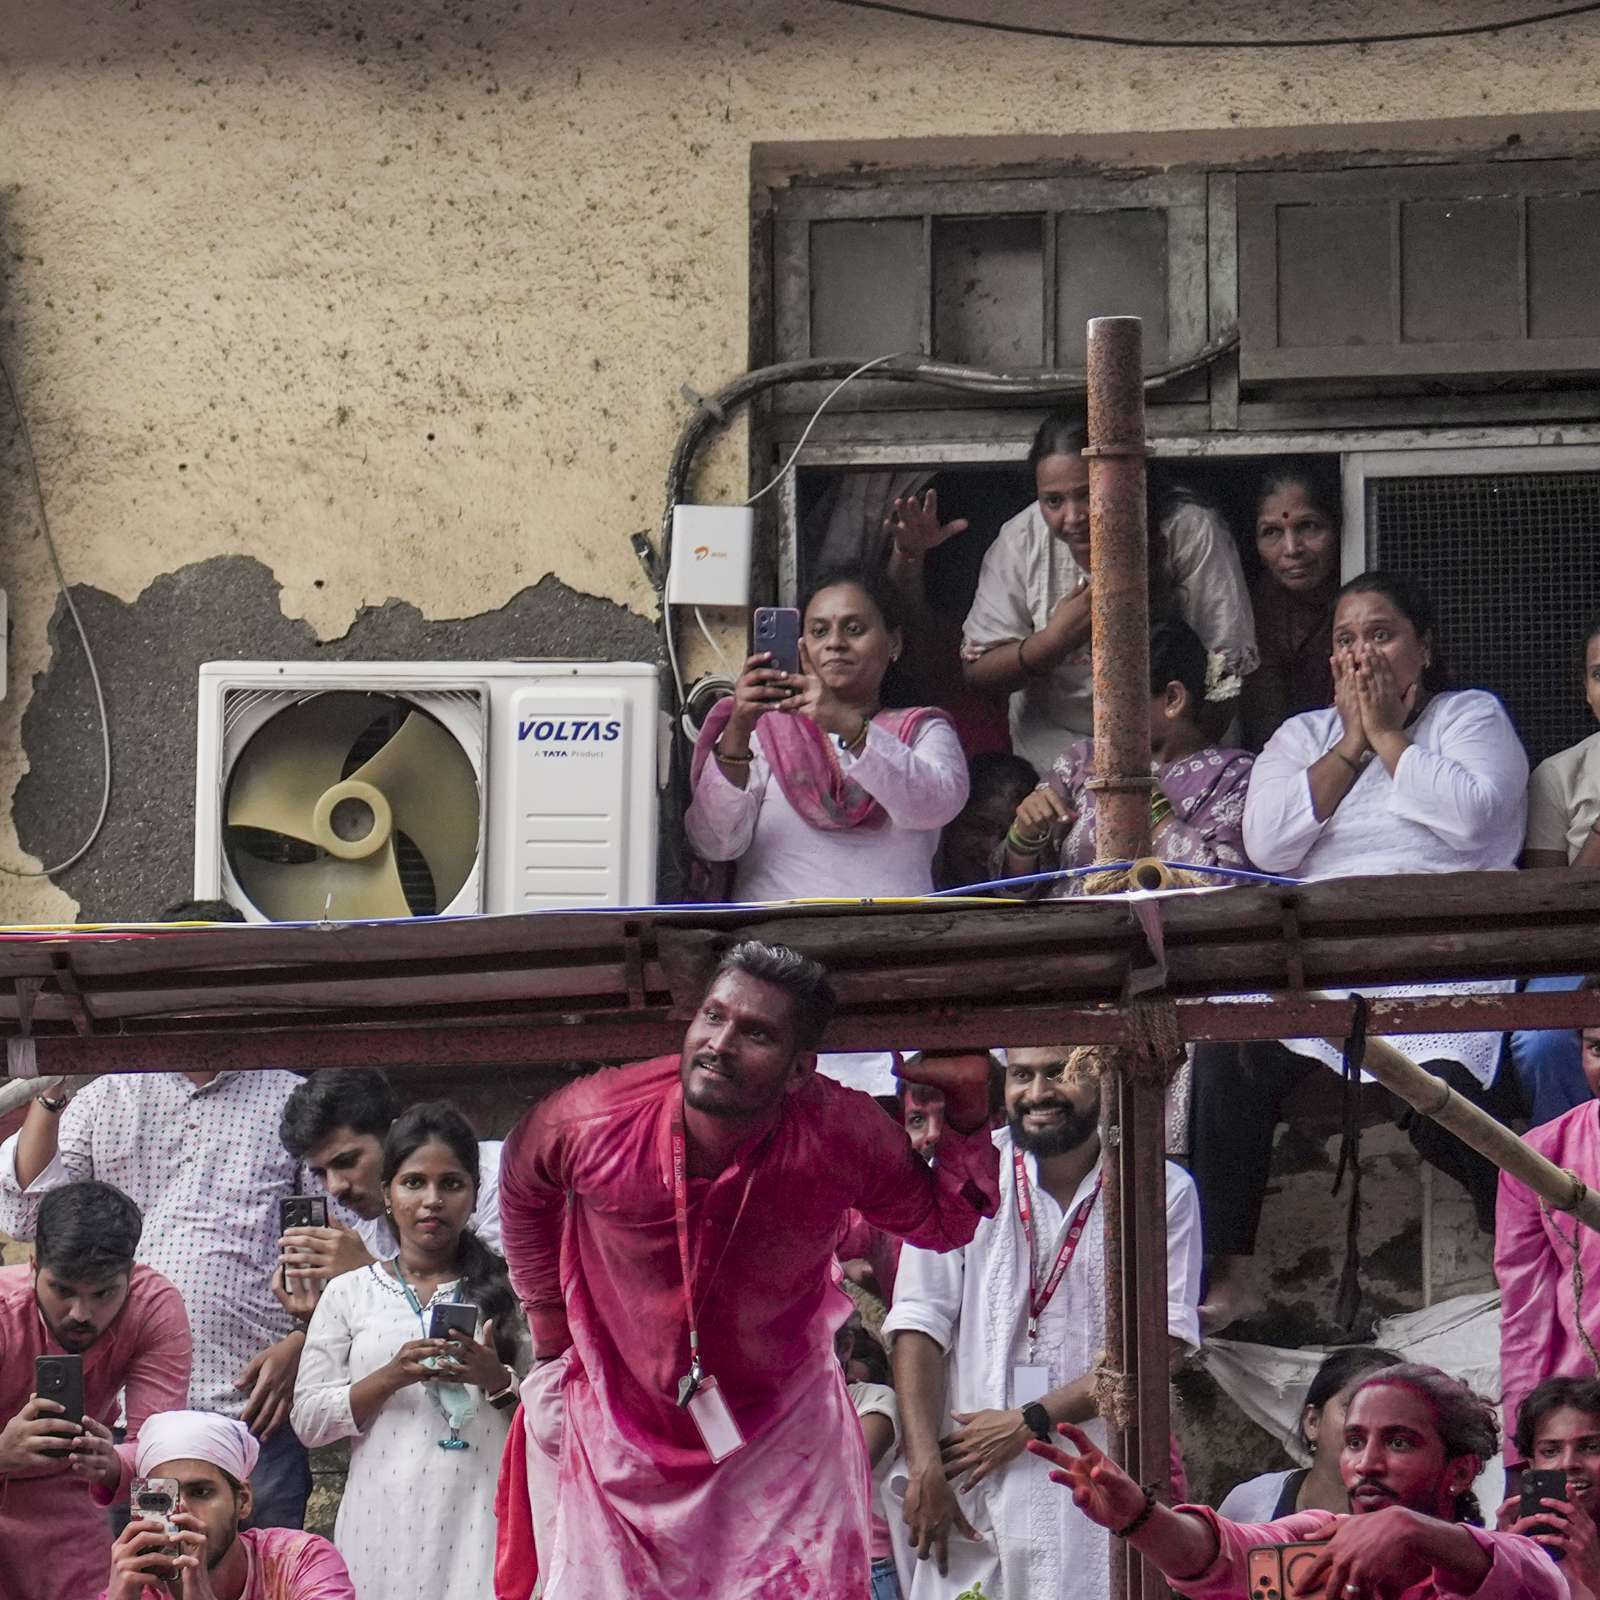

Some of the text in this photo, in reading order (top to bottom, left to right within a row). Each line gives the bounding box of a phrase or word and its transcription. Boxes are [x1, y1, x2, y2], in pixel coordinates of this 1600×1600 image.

[518, 721, 621, 741] VOLTAS
[542, 750, 568, 758] TATA
[571, 750, 604, 758] Product
